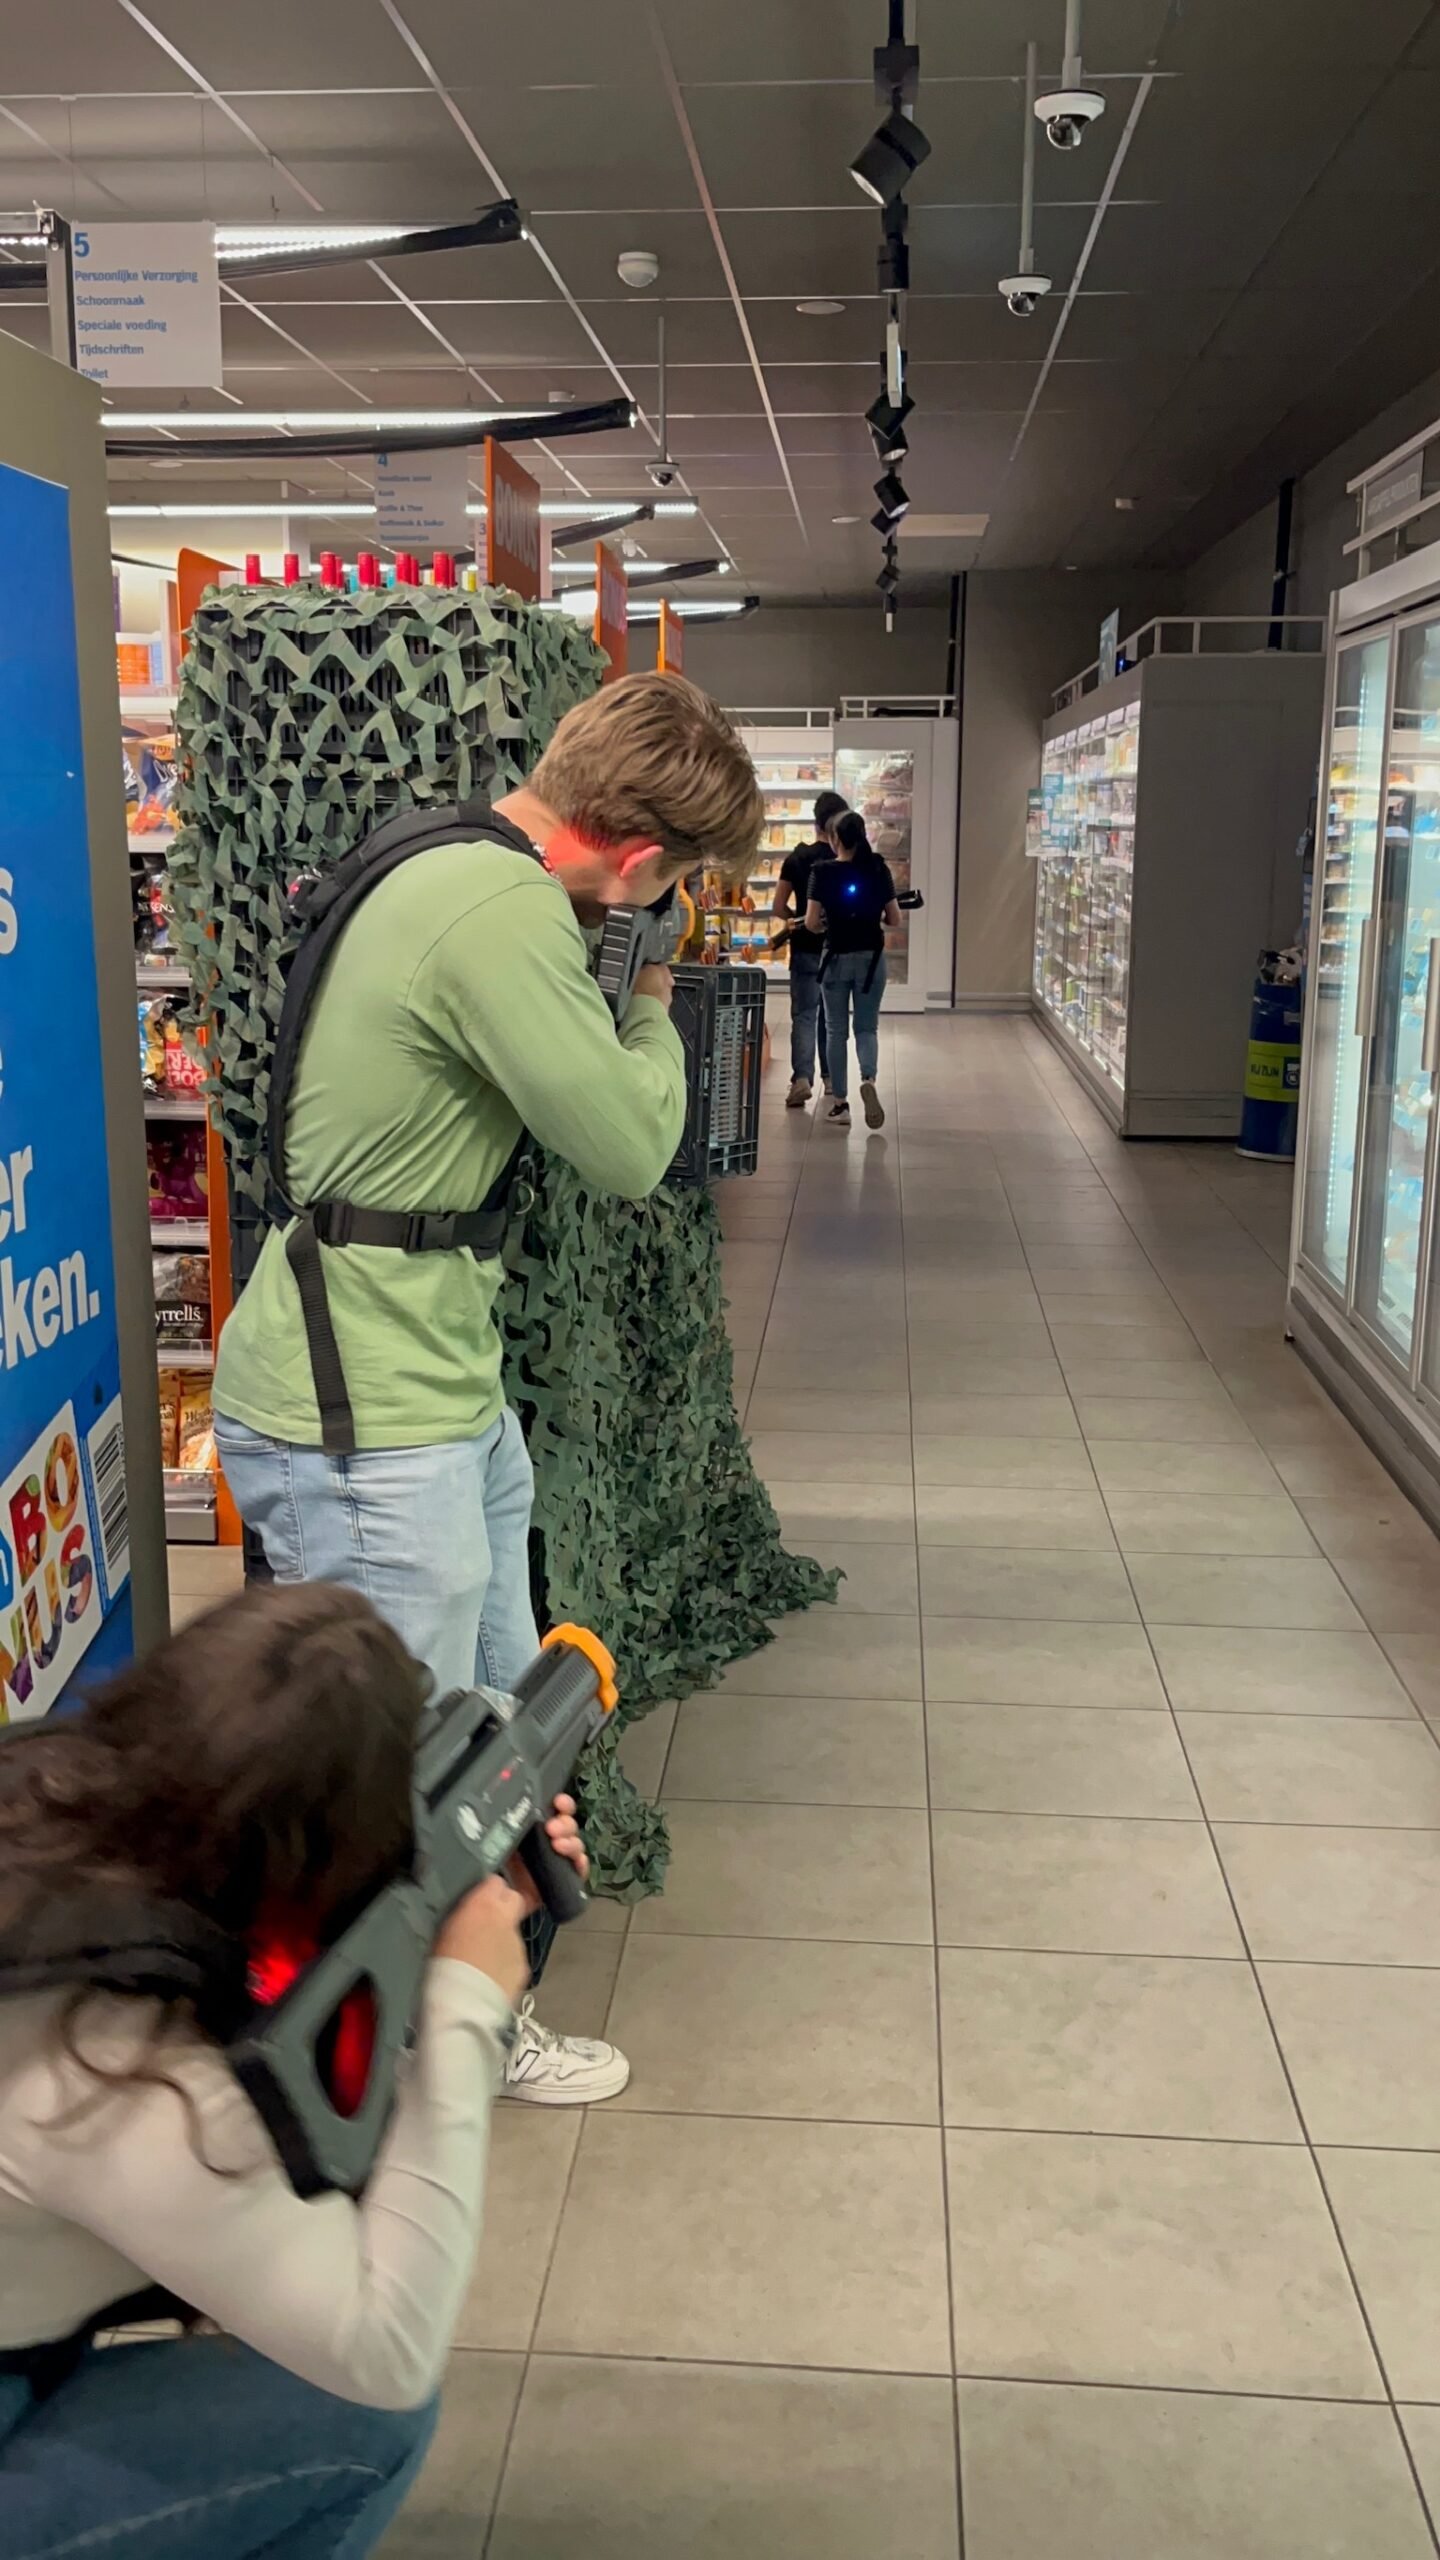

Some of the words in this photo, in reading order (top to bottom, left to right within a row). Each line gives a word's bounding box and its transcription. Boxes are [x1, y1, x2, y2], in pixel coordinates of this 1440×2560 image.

[74, 232, 90, 258] 5
[74, 269, 139, 283] Persoonlijke
[141, 269, 199, 283] Verzorging
[76, 295, 145, 306] Schoonmaak
[78, 319, 122, 332] Speciale
[125, 319, 167, 332] voeding
[79, 344, 144, 356] Tijdschriften
[0, 1250, 100, 1372] ken.
[155, 1304, 202, 1327] yrrells
[9, 1431, 79, 1588] BO
